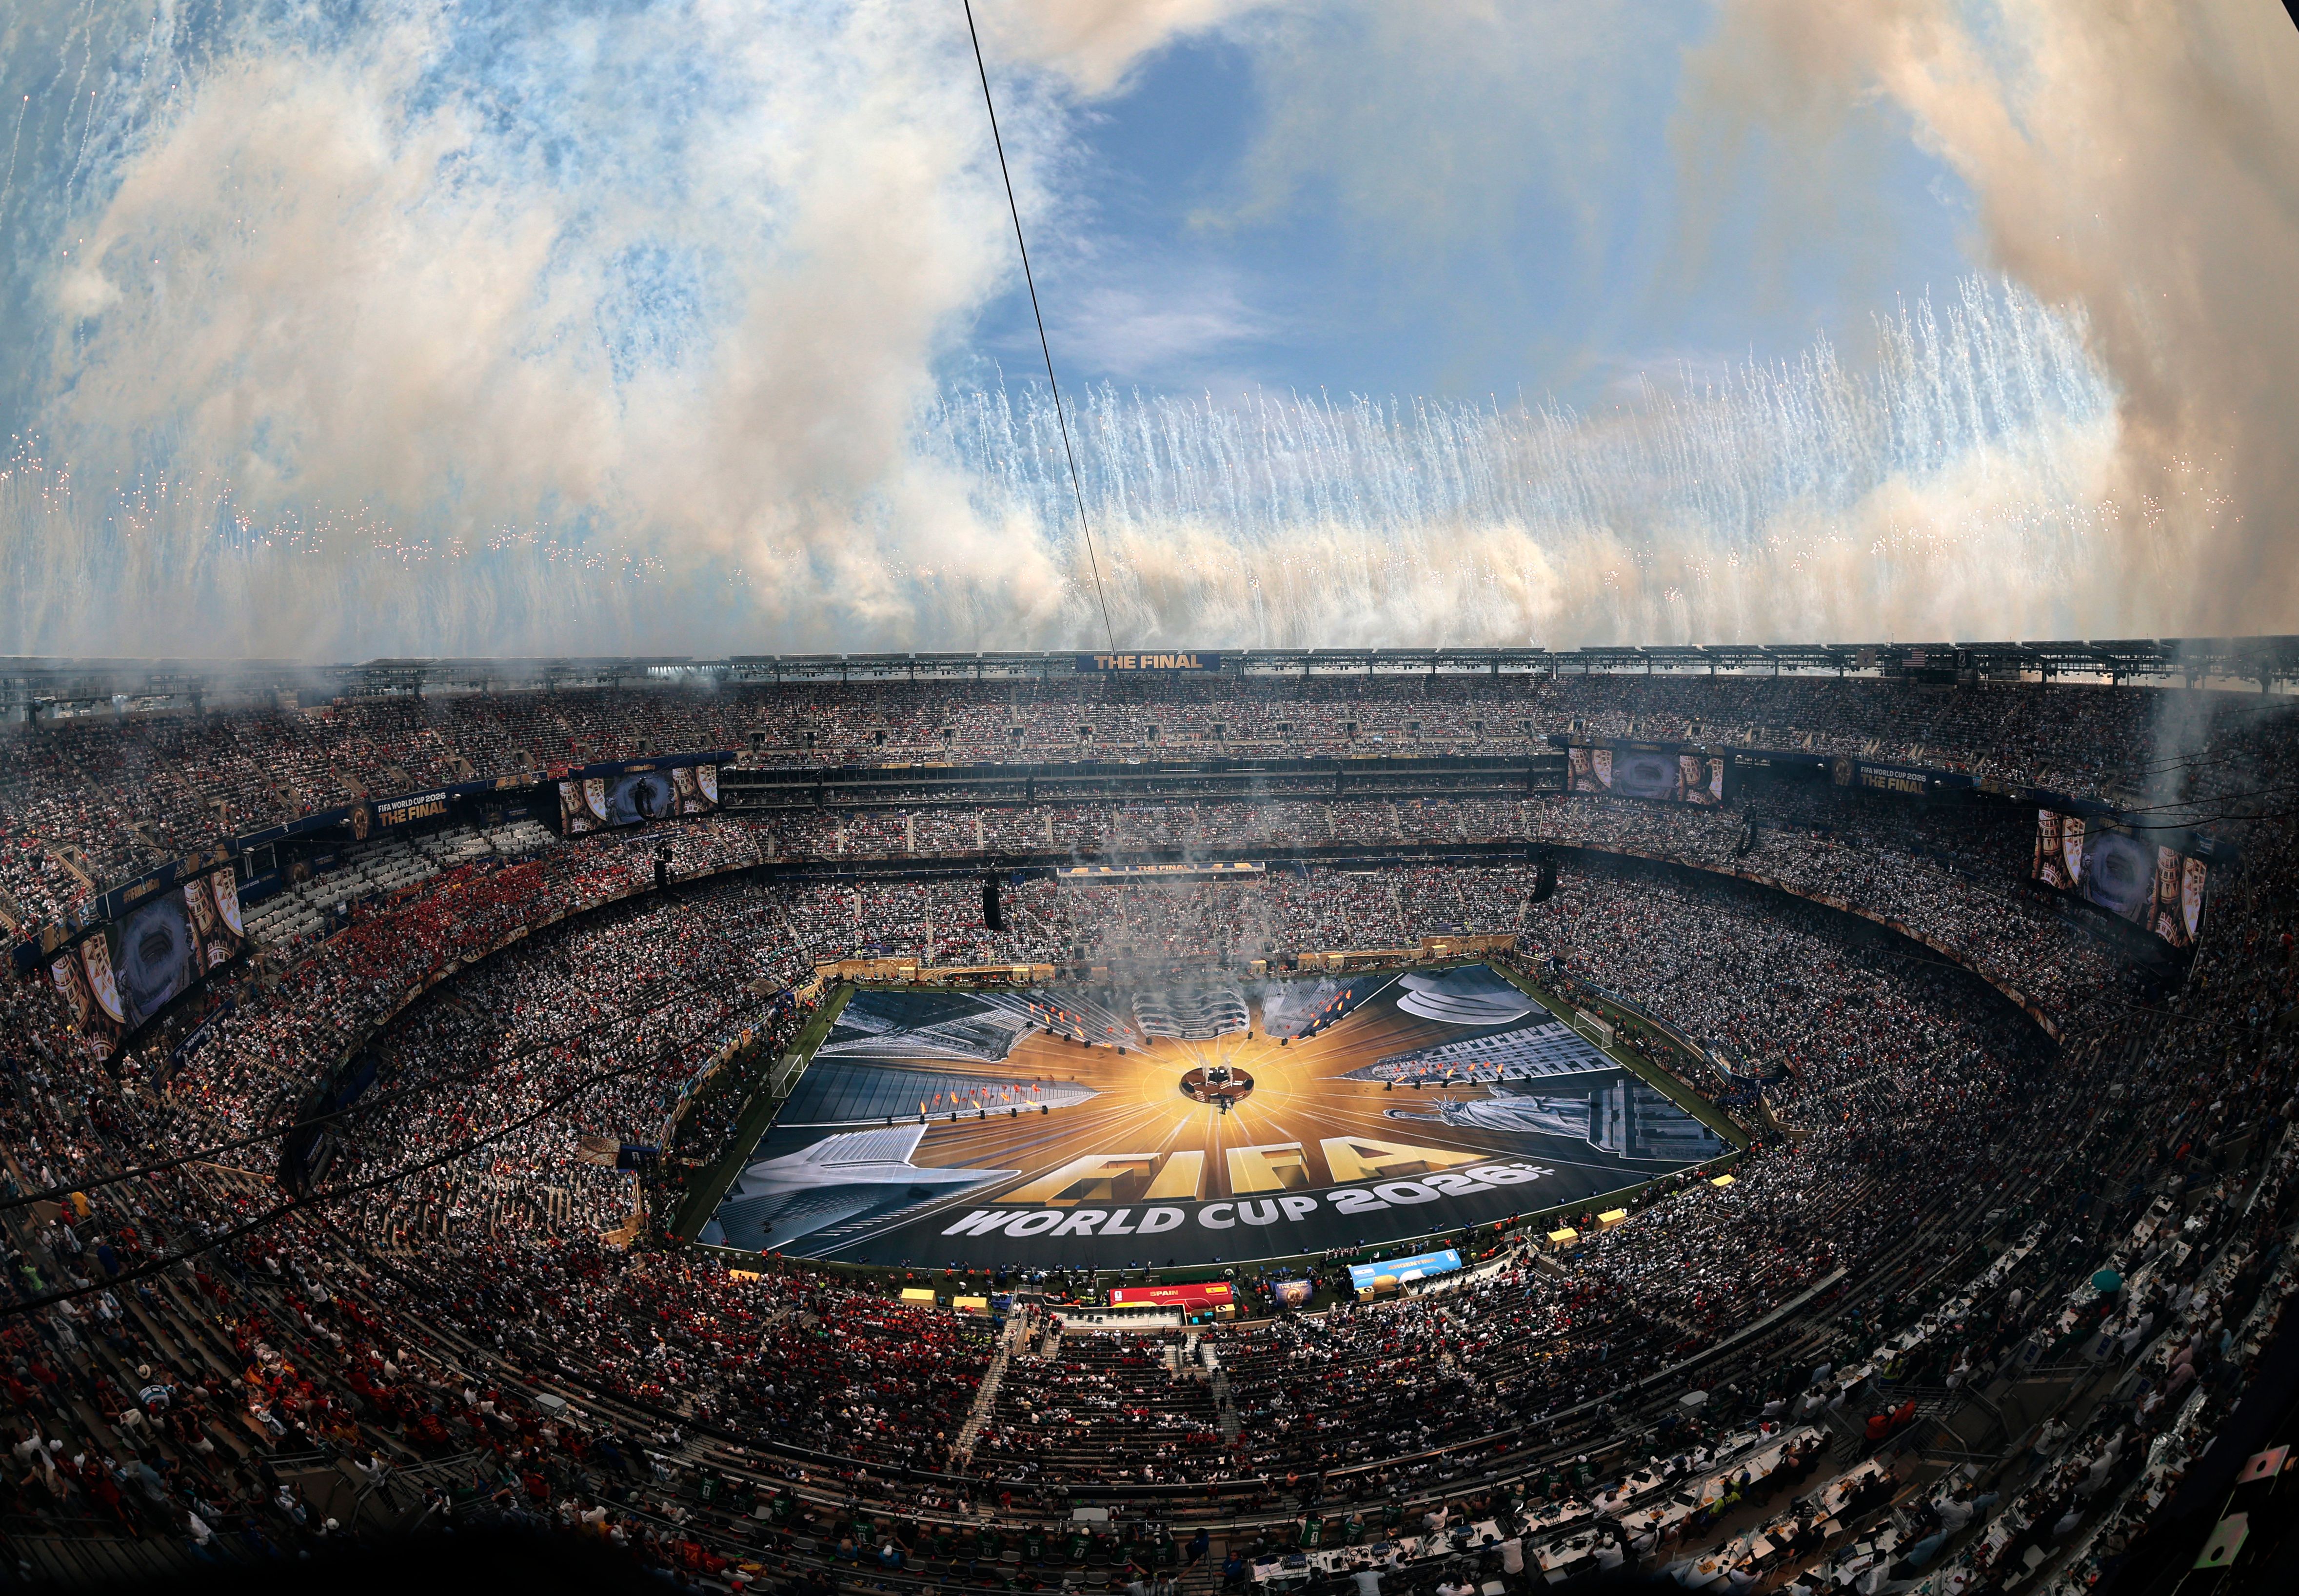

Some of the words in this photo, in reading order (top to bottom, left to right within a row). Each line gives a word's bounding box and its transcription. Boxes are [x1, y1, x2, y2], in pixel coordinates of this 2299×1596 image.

[1093, 655, 1136, 669] THE
[1141, 655, 1203, 669] FINAL
[1873, 768, 1894, 777] WORLD
[1906, 772, 1926, 782] 2026
[1861, 773, 1885, 788] THE
[1887, 777, 1925, 795] FINAL
[377, 804, 391, 813] FIFA
[392, 800, 413, 810] WORLD
[413, 796, 425, 805] CUP
[425, 792, 446, 803] 2026
[378, 808, 406, 827] THE
[408, 800, 447, 821] FINAL
[991, 1136, 1494, 1206] FIFA
[941, 1207, 1185, 1237] WORLD
[1198, 1196, 1318, 1229] CUP
[1326, 1165, 1539, 1215] 2026
[1388, 1258, 1436, 1269] ARGENTINA
[427, 1424, 441, 1435] 26
[707, 1560, 714, 1572] 5
